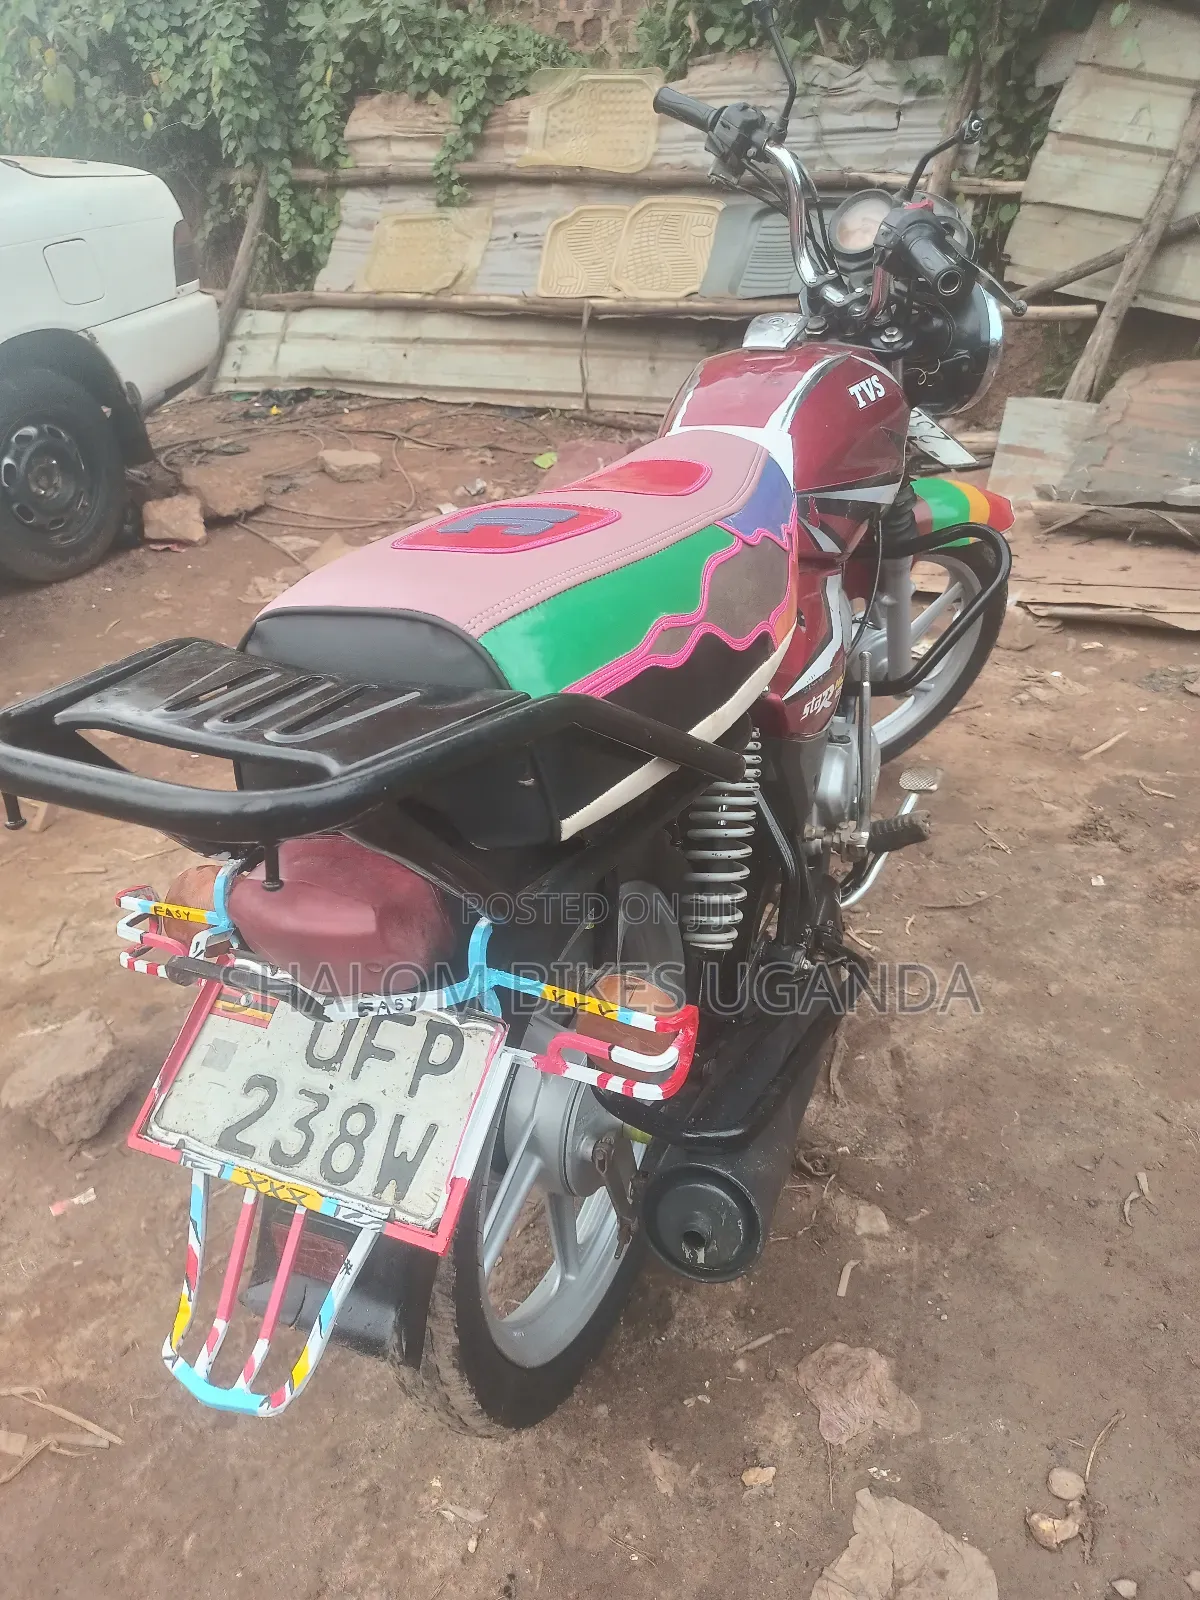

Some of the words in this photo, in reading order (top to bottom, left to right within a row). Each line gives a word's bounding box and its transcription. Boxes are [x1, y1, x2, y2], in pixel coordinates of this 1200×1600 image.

[848, 374, 886, 409] TVS
[153, 905, 191, 921] EASY
[357, 995, 418, 1018] EASY
[305, 1012, 465, 1098] UFP
[216, 1074, 439, 1202] 238W
